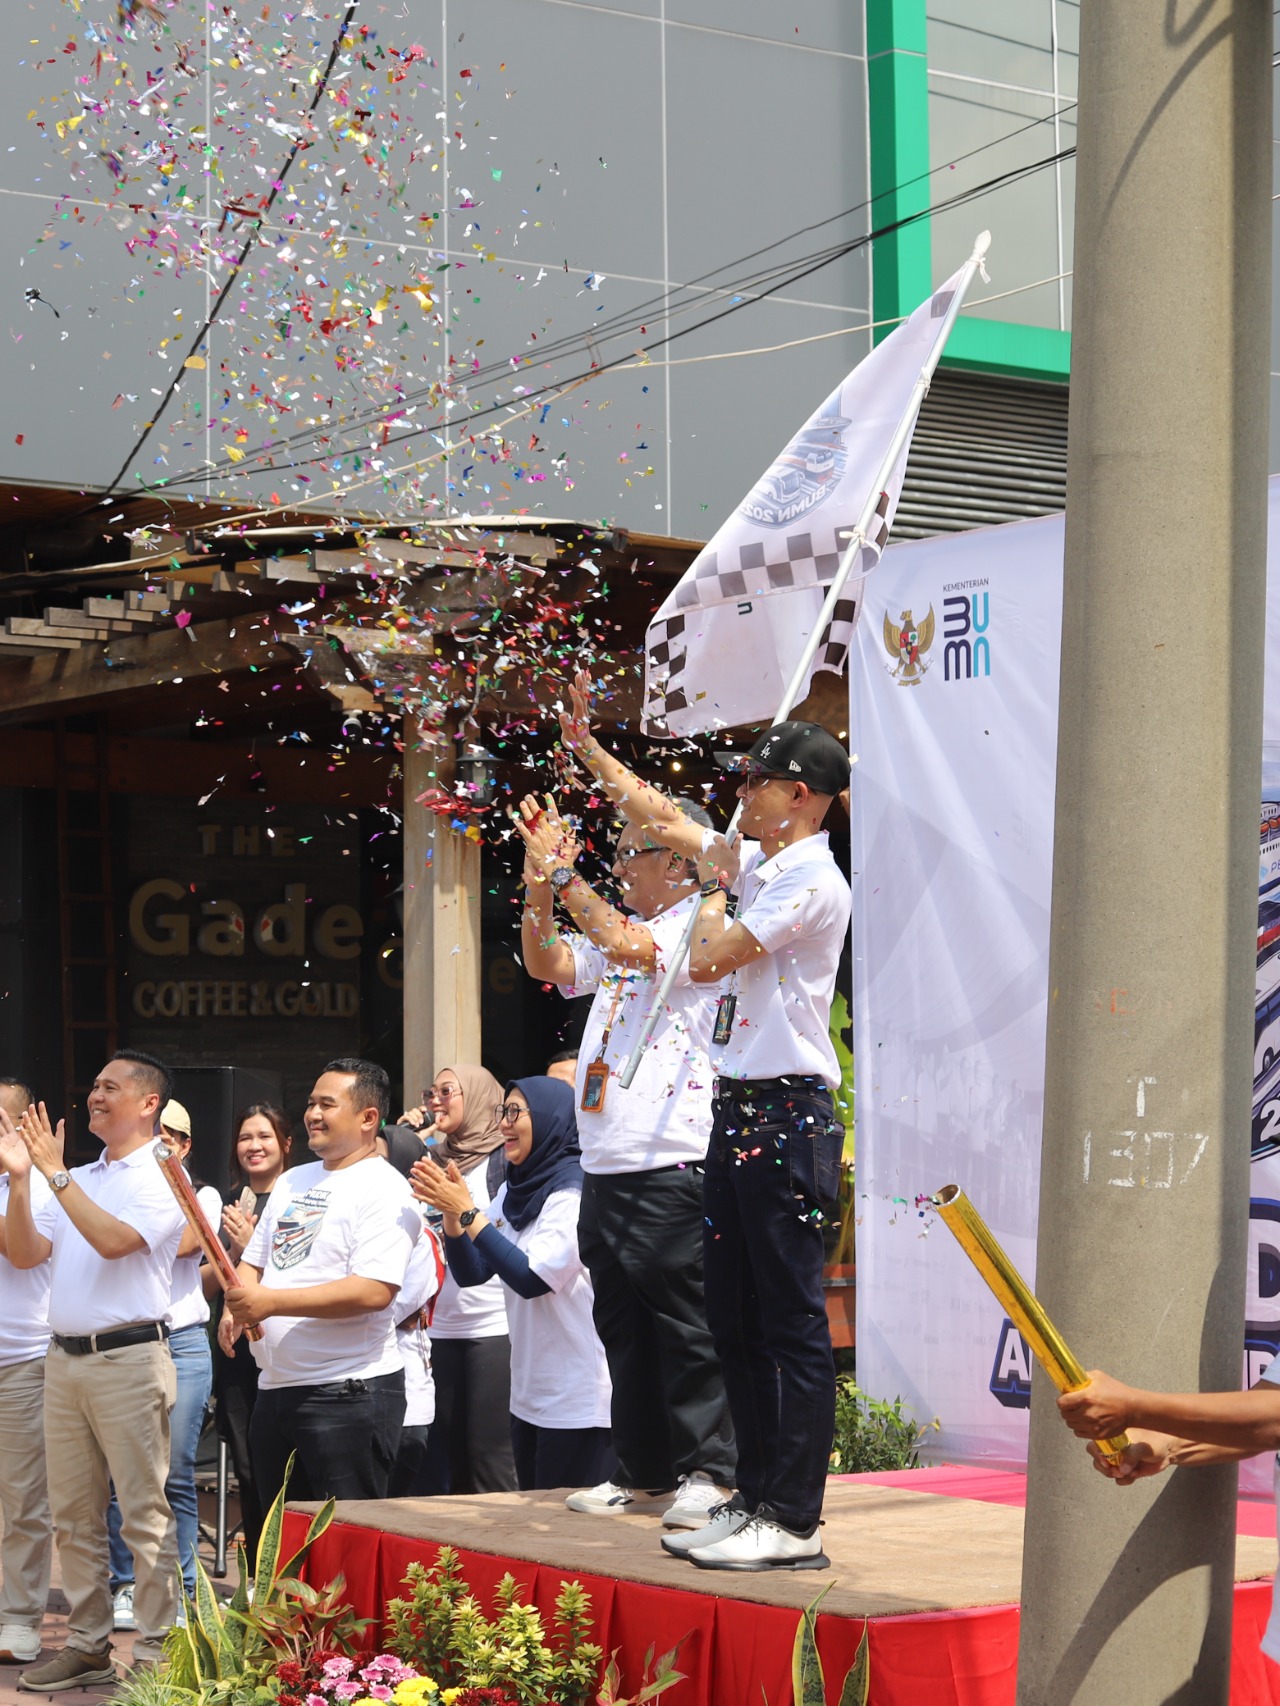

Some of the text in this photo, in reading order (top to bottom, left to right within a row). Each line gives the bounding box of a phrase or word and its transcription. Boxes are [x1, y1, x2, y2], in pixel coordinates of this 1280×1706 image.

[943, 578, 989, 592] KEMENTERIAN
[197, 825, 297, 856] THE
[129, 877, 364, 960] Gade
